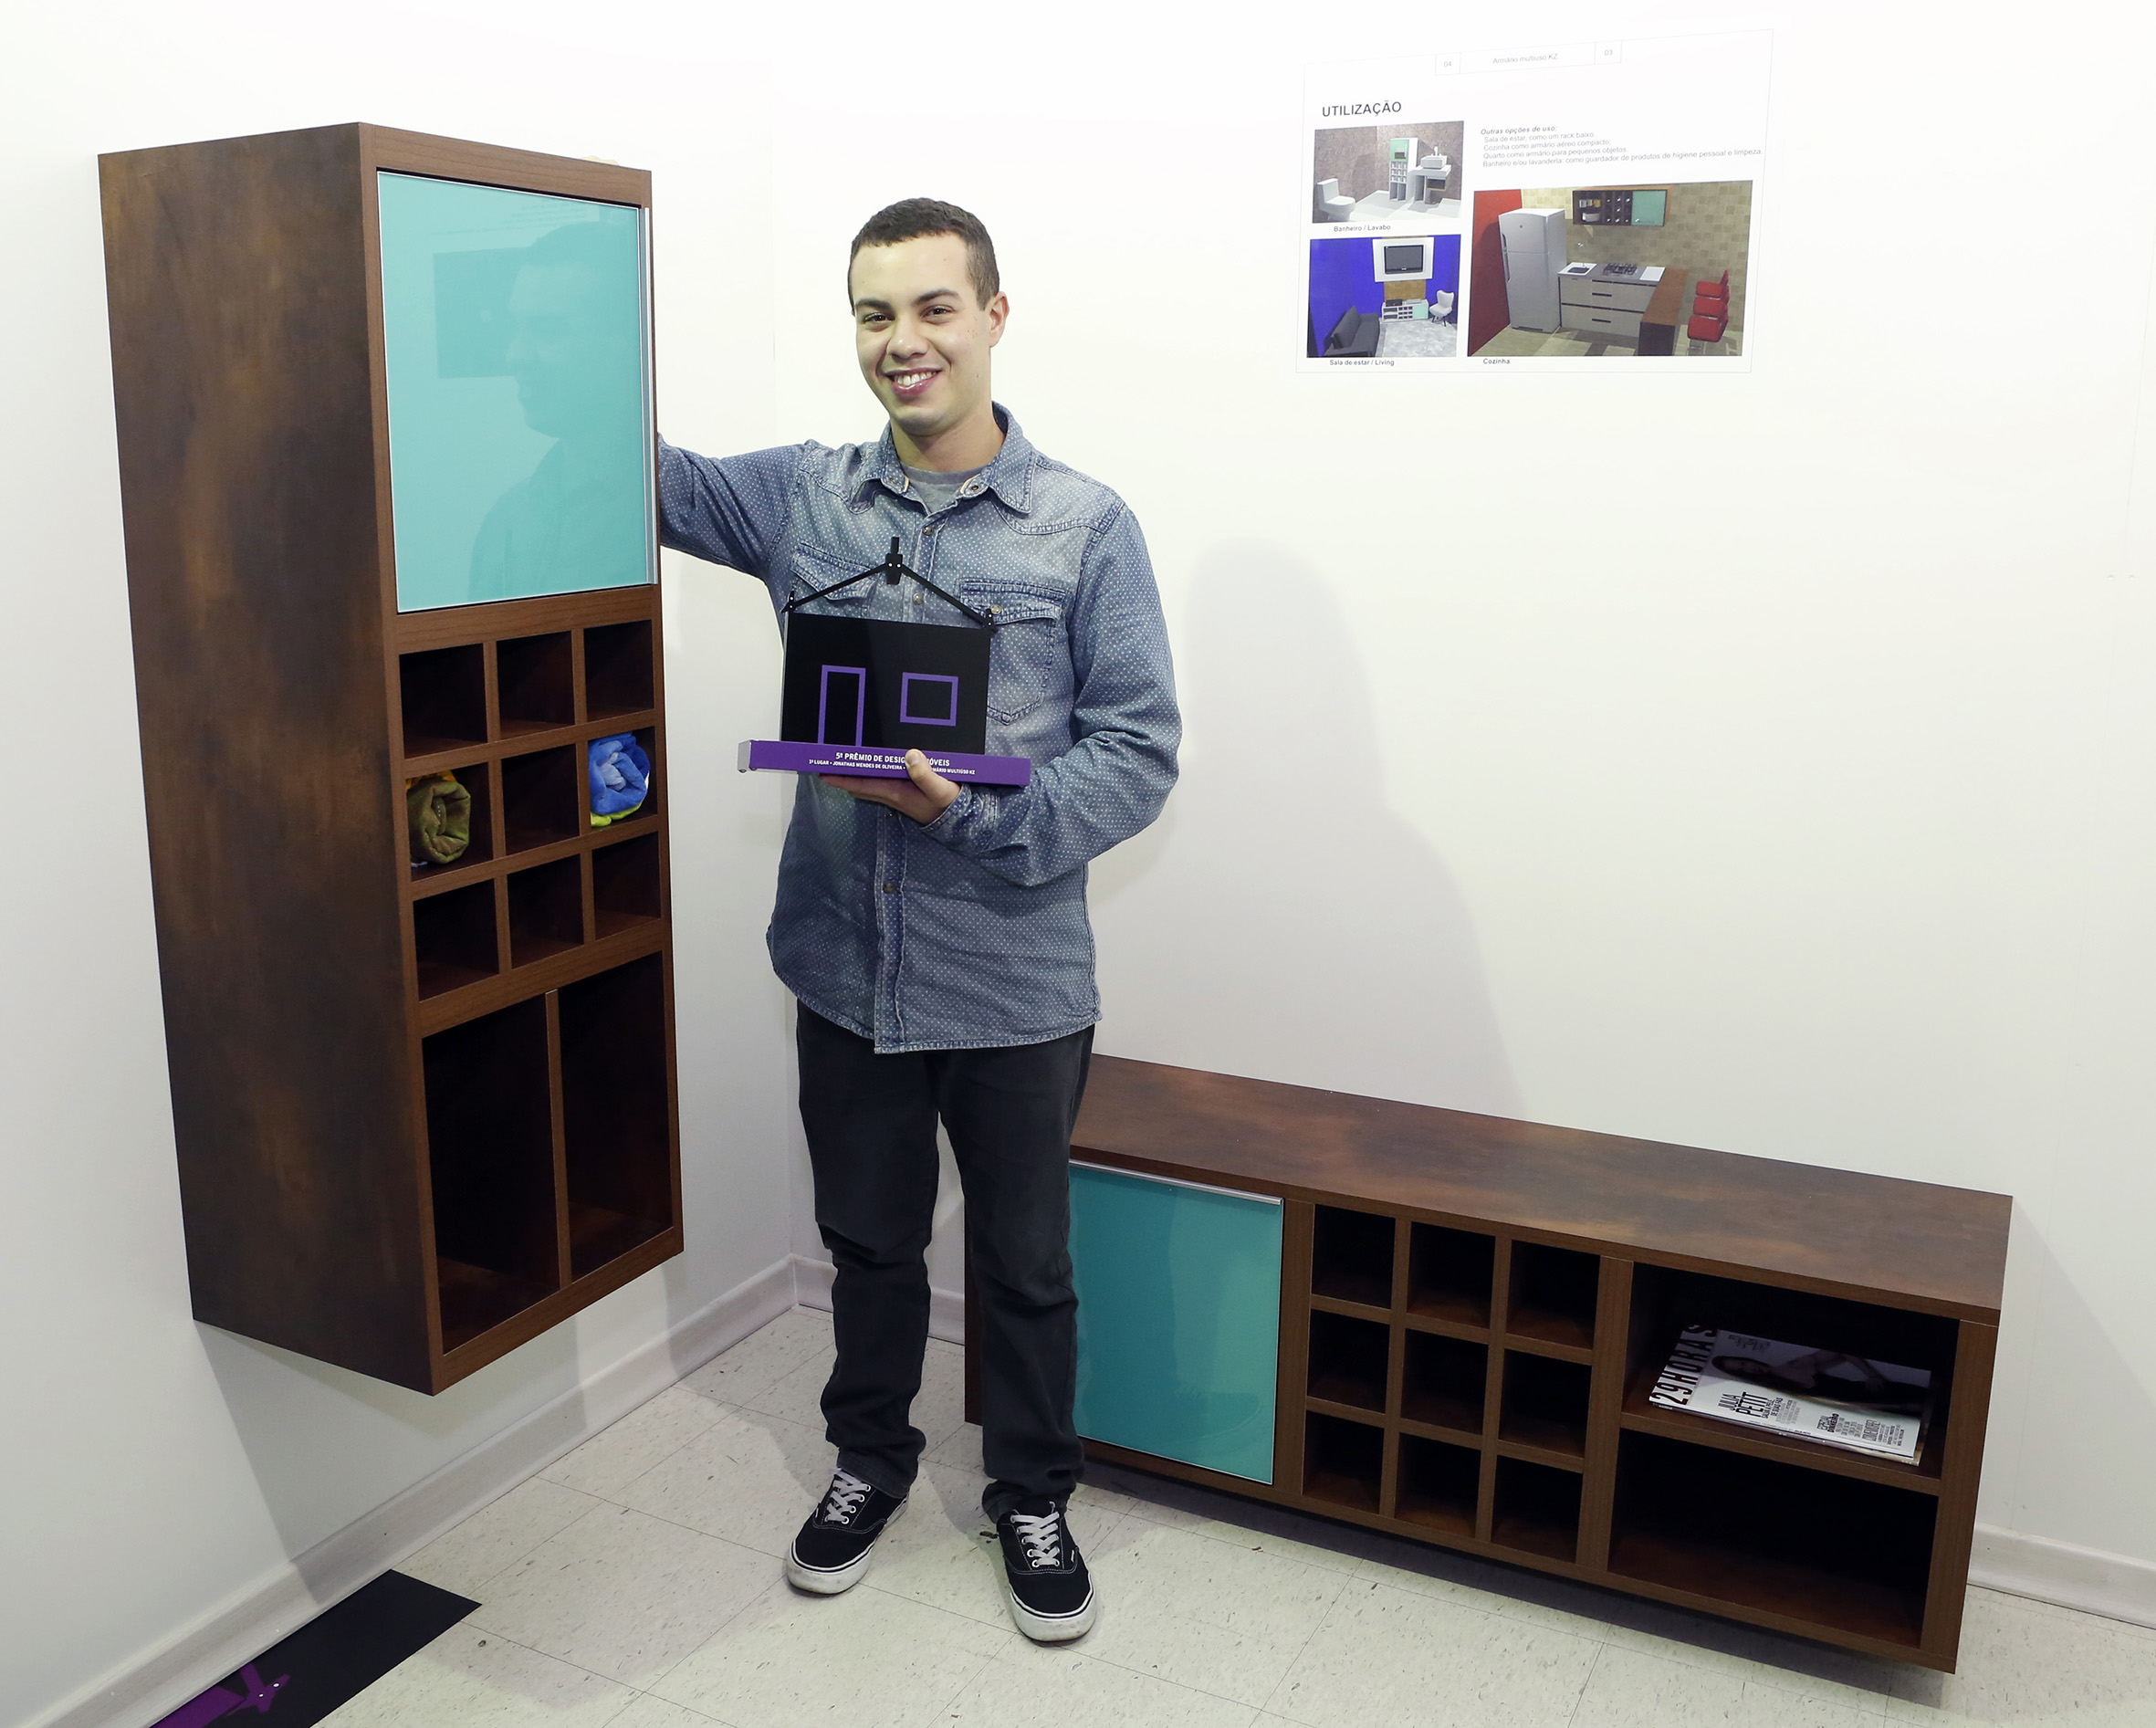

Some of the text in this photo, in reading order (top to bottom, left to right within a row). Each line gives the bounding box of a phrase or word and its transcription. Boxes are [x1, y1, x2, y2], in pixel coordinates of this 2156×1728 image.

[1322, 99, 1402, 117] UTILIZAÇÃO
[1586, 155, 1619, 164] guardador
[1672, 152, 1698, 160] higiene
[1700, 150, 1725, 158] pessoal
[844, 752, 873, 761] PRÊMIO
[884, 755, 905, 763] DESIG
[1718, 1393, 1742, 1411] JULIA
[1735, 1391, 1767, 1417] PETIT
